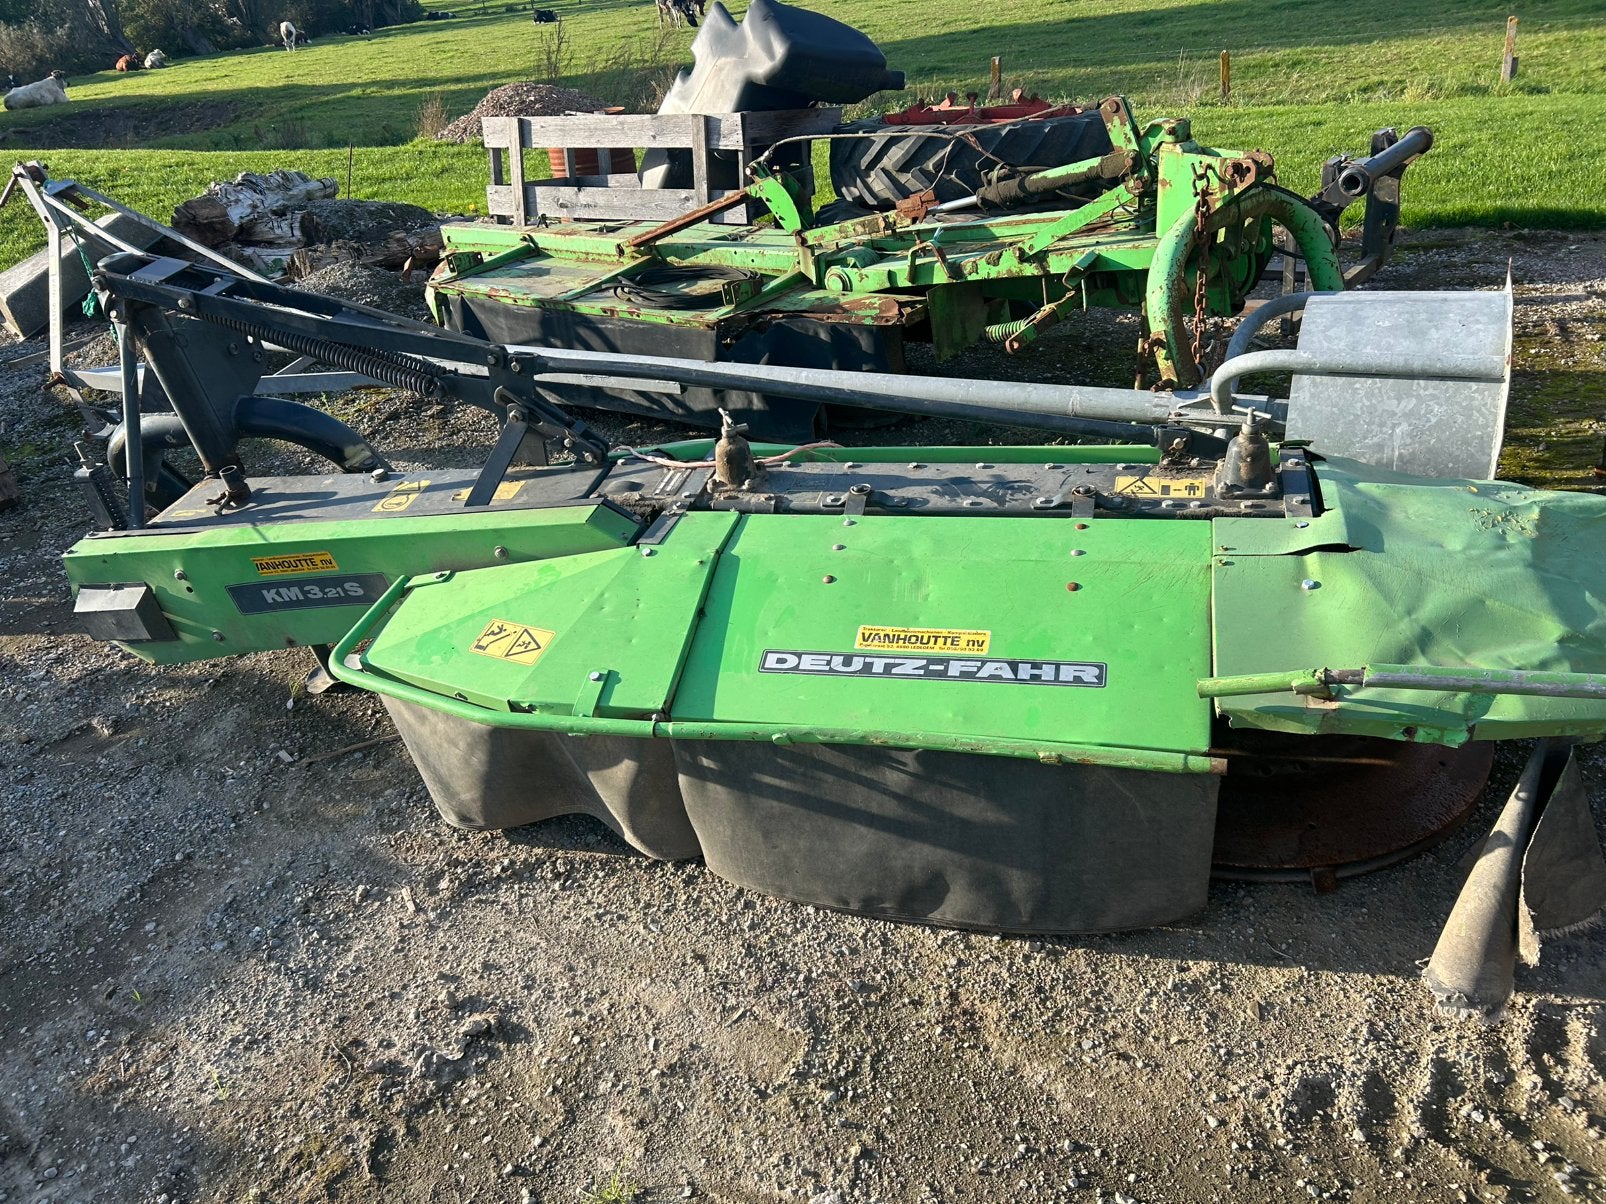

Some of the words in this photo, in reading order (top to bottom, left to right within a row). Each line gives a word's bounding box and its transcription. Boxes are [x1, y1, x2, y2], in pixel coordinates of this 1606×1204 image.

[262, 586, 304, 604] KM
[861, 632, 961, 647] VANHOUTTE
[966, 639, 986, 648] nv
[764, 652, 1099, 683] DEUTZ-FAHR
